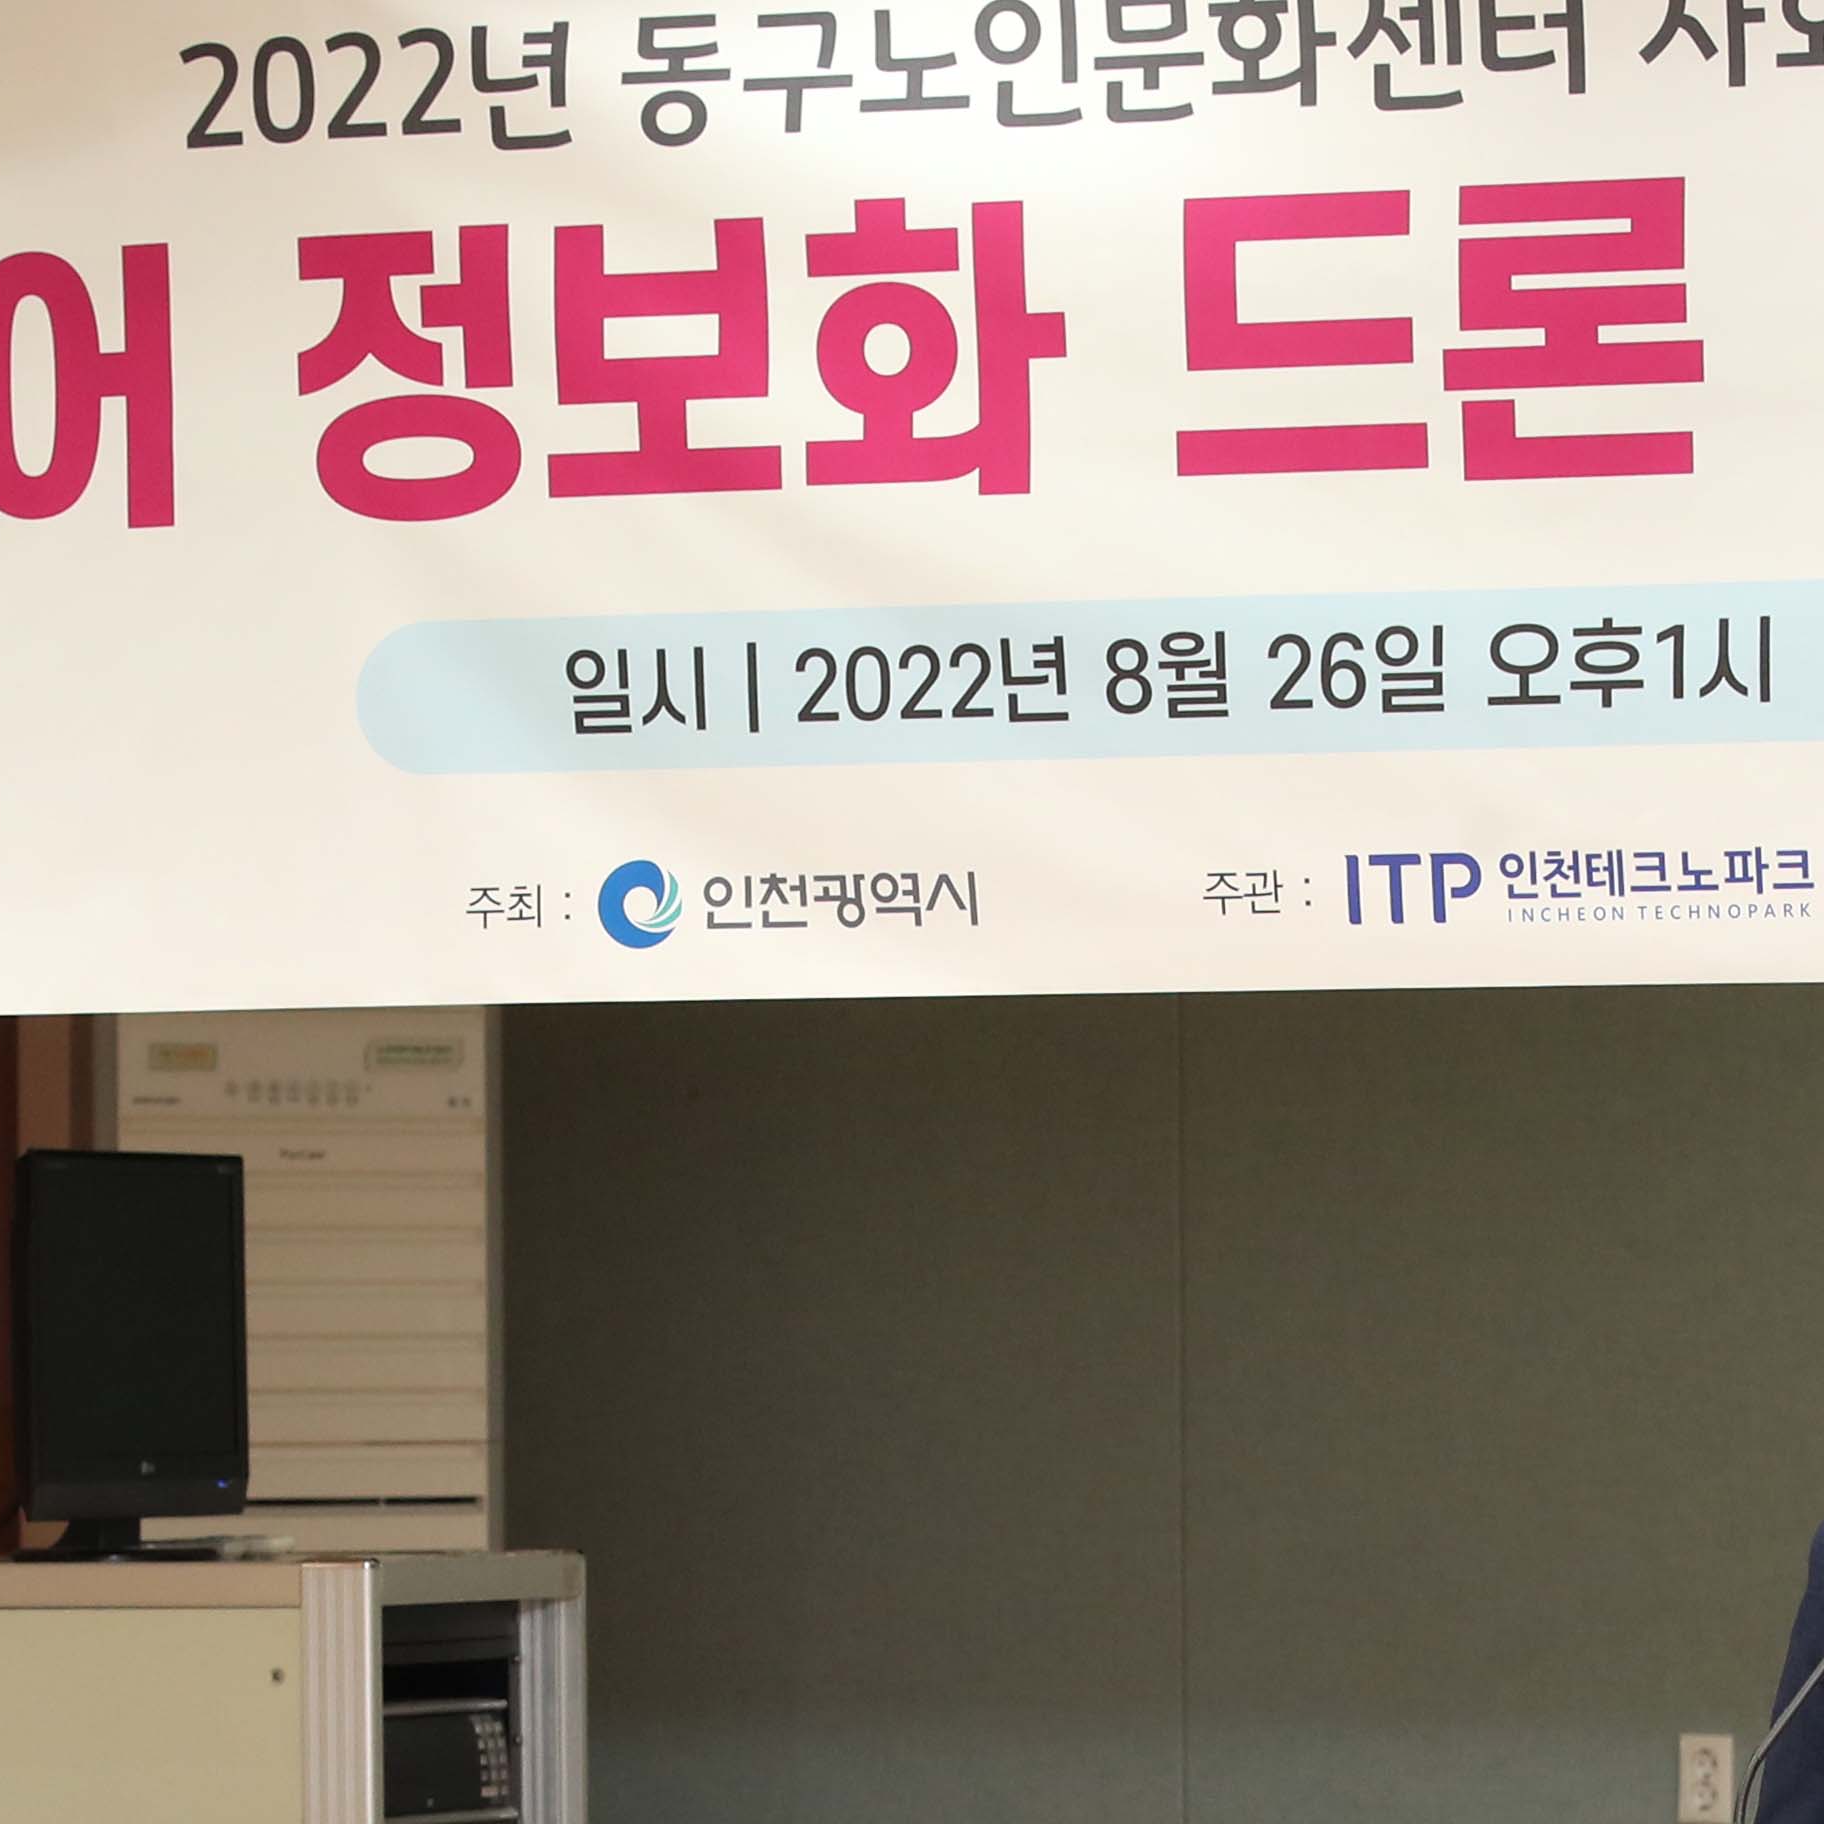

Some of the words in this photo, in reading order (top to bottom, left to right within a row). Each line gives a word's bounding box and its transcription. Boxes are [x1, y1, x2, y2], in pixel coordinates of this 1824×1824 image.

[178, 21, 573, 151] 2022년
[297, 197, 1068, 523] 정보화
[1176, 176, 1705, 482] 드론
[565, 646, 707, 735] 일시
[795, 635, 1070, 723] 2022년
[1105, 630, 1229, 719] 8월
[1267, 624, 1445, 714] 26일
[1487, 615, 1771, 709] 오후1시
[465, 884, 542, 929] 주최
[703, 871, 979, 930] 인천광역시
[1202, 869, 1284, 916] 주관
[1344, 852, 1482, 925] ITP
[1499, 846, 1815, 900] 인천테크노파크
[1507, 906, 1624, 923] INCHEON
[1636, 902, 1811, 921] TECHNOPARK
